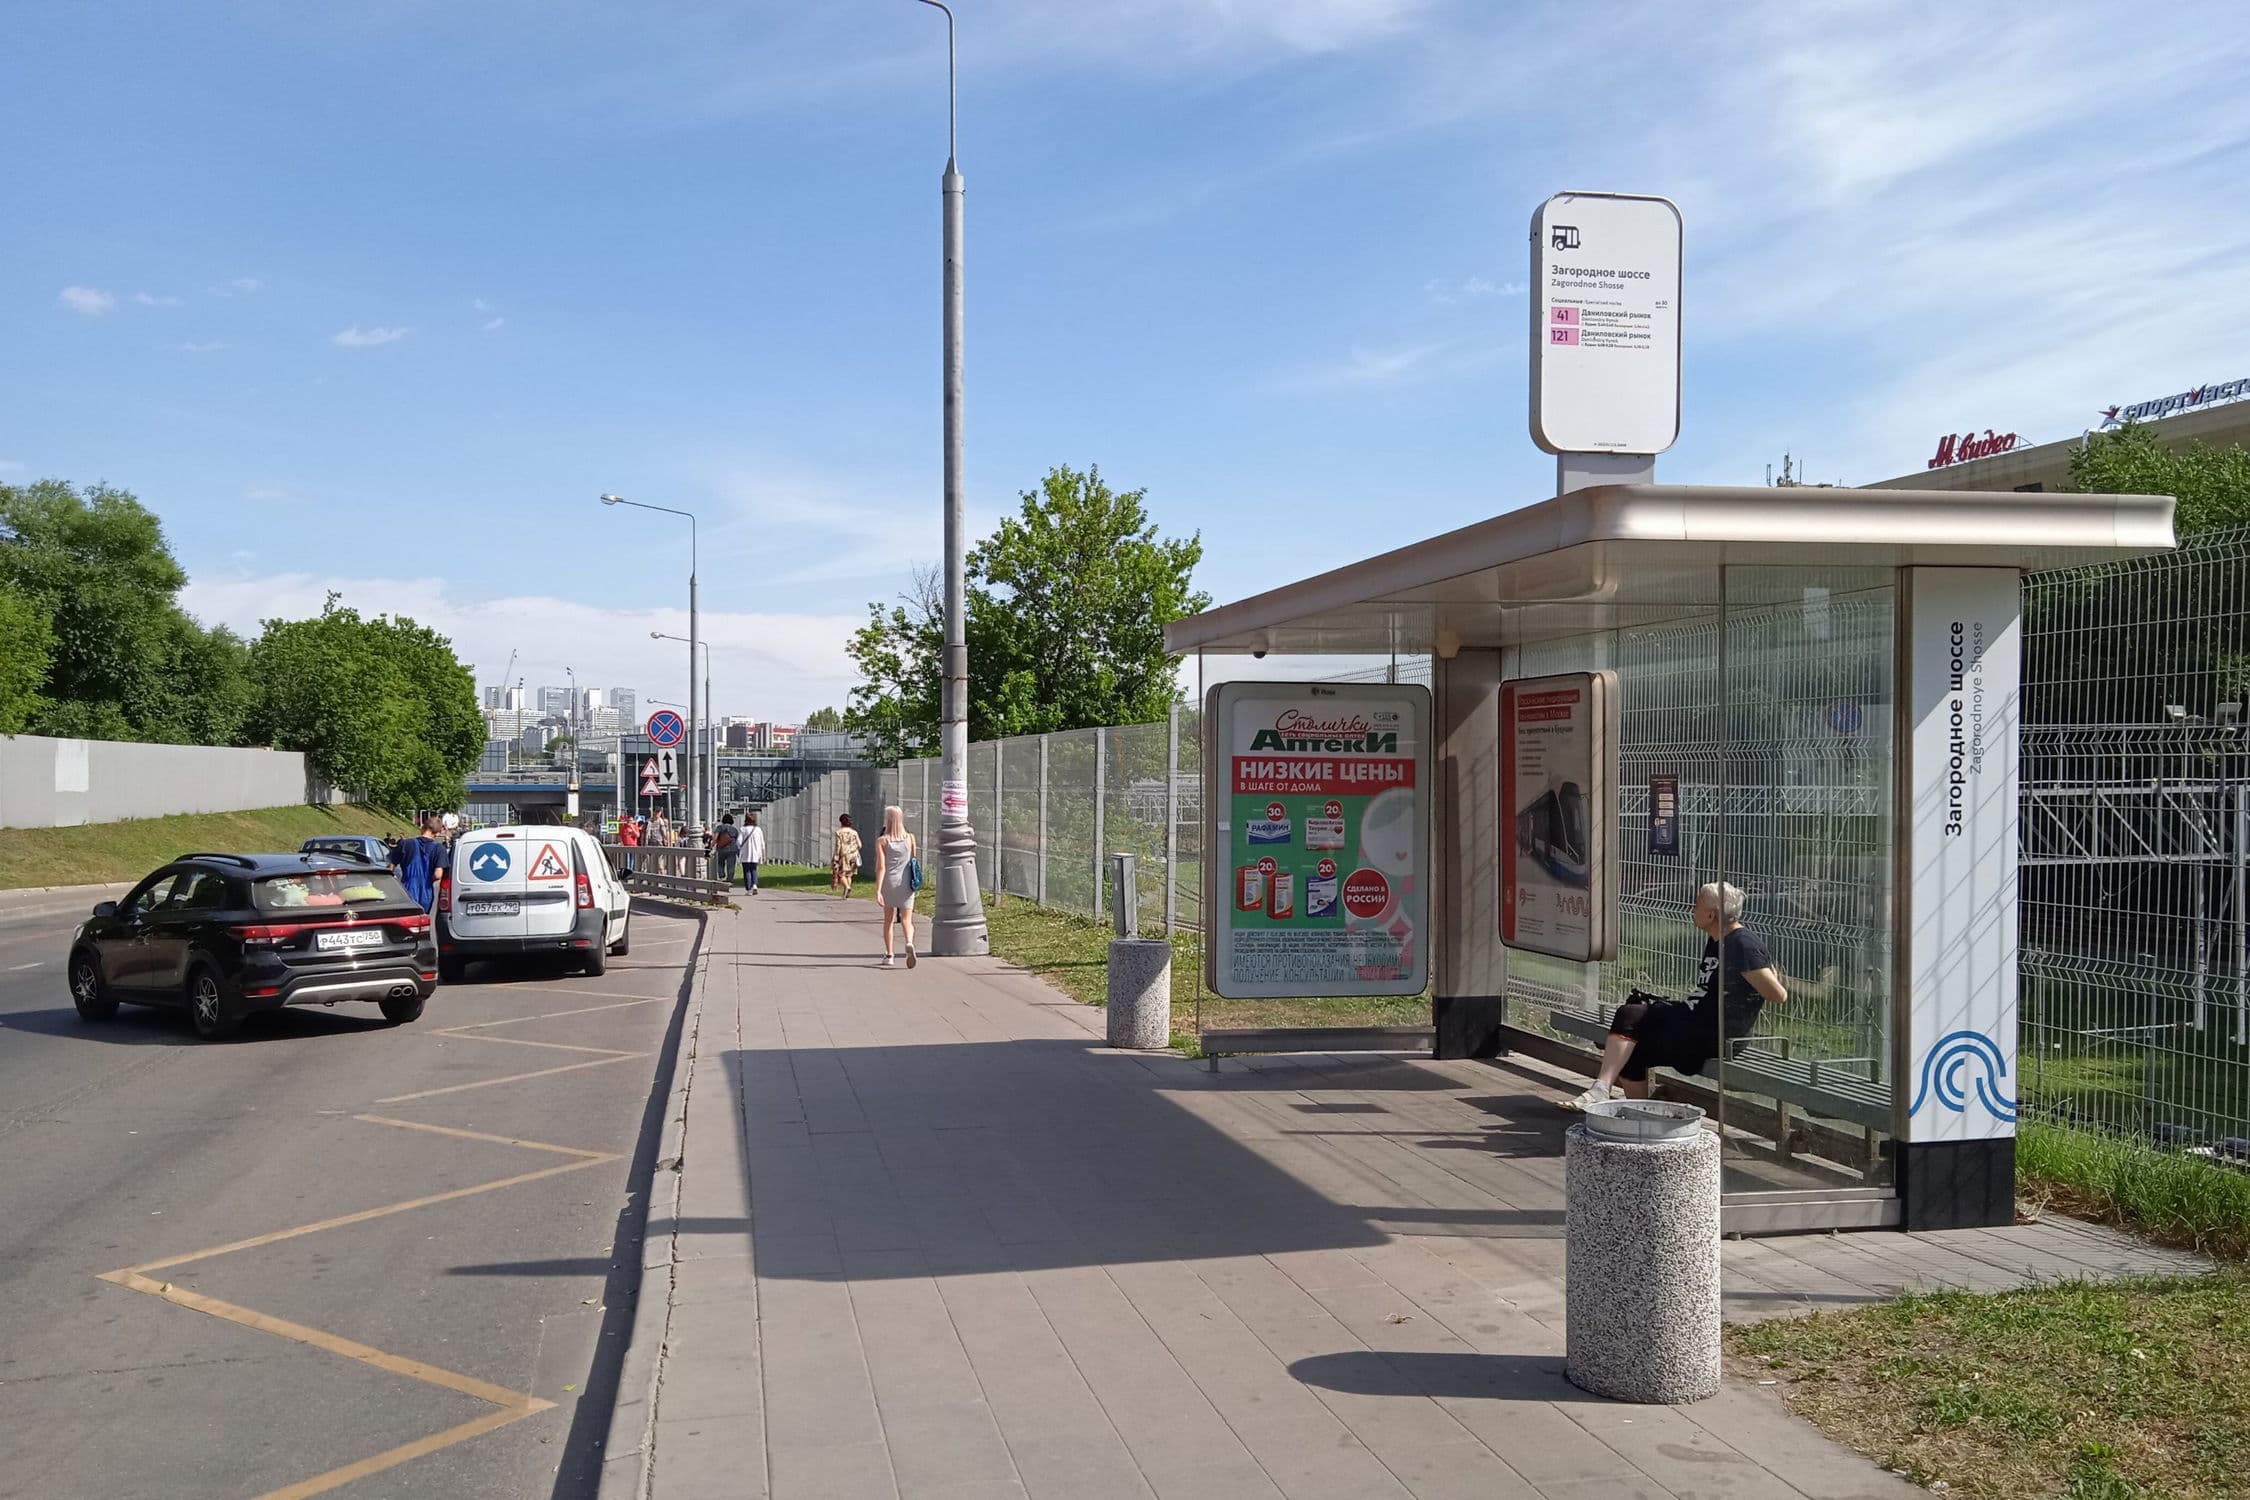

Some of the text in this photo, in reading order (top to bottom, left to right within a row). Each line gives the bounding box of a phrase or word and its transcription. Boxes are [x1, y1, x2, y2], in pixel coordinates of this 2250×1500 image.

[1551, 264, 1651, 280] Загородное шоссе
[1551, 279, 1624, 290] Zagorodnoe Shosse
[1556, 310, 1569, 321] 41
[1581, 309, 1652, 320] Даниловский рынок
[1551, 330, 1568, 342] 121
[1581, 329, 1651, 341] Даниловский рынок
[1969, 621, 1984, 775] Zagorodnoye Shosse
[1945, 621, 1966, 837] Загородное шоссе
[1240, 760, 1404, 783] НИЗКИЕ ЦЕНЫ
[1240, 782, 1321, 793] В ШАГЕ ОТ ДОМА
[1346, 885, 1380, 893] СДЕЛАНО
[1346, 895, 1386, 903] РОССИИ
